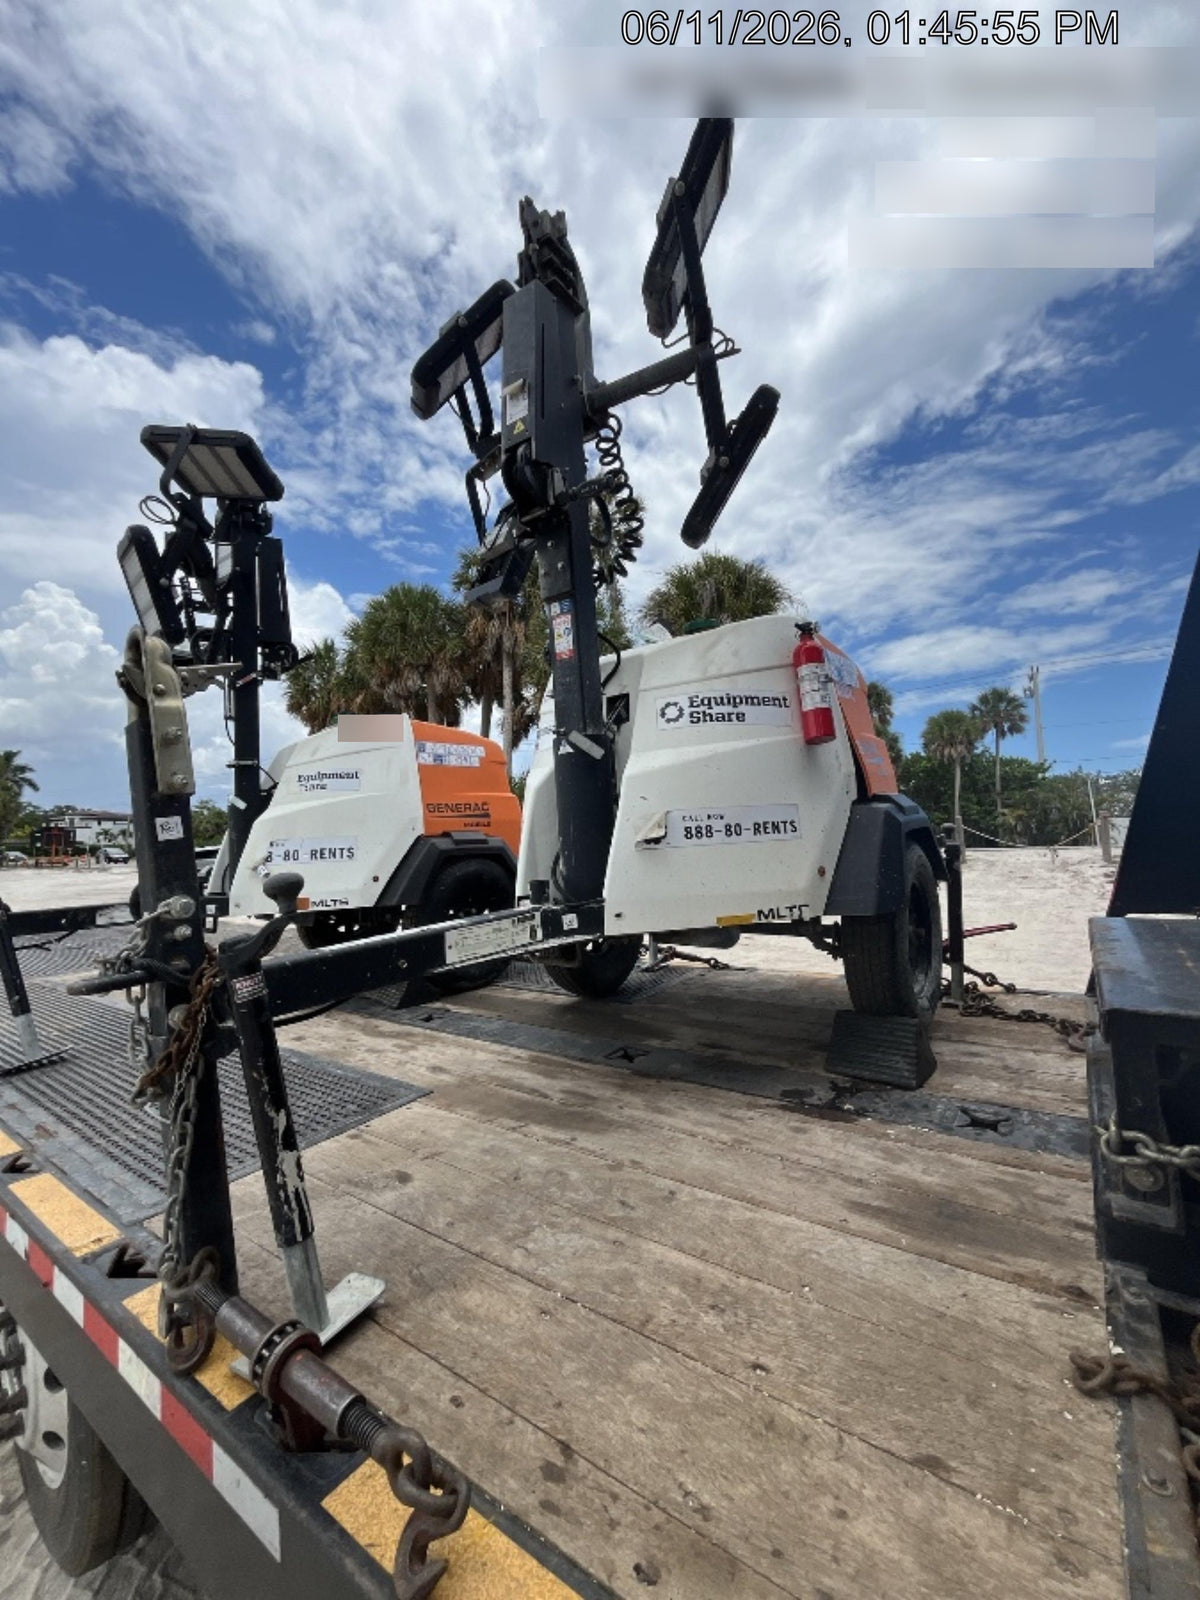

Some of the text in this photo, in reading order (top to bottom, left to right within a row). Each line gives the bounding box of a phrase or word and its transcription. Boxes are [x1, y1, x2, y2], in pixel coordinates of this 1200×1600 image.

[687, 692, 791, 710] Equipment
[689, 710, 746, 724] Share
[297, 771, 360, 783] Equipment
[426, 801, 490, 814] GENERAC
[683, 819, 798, 840] 888-80-RENTS
